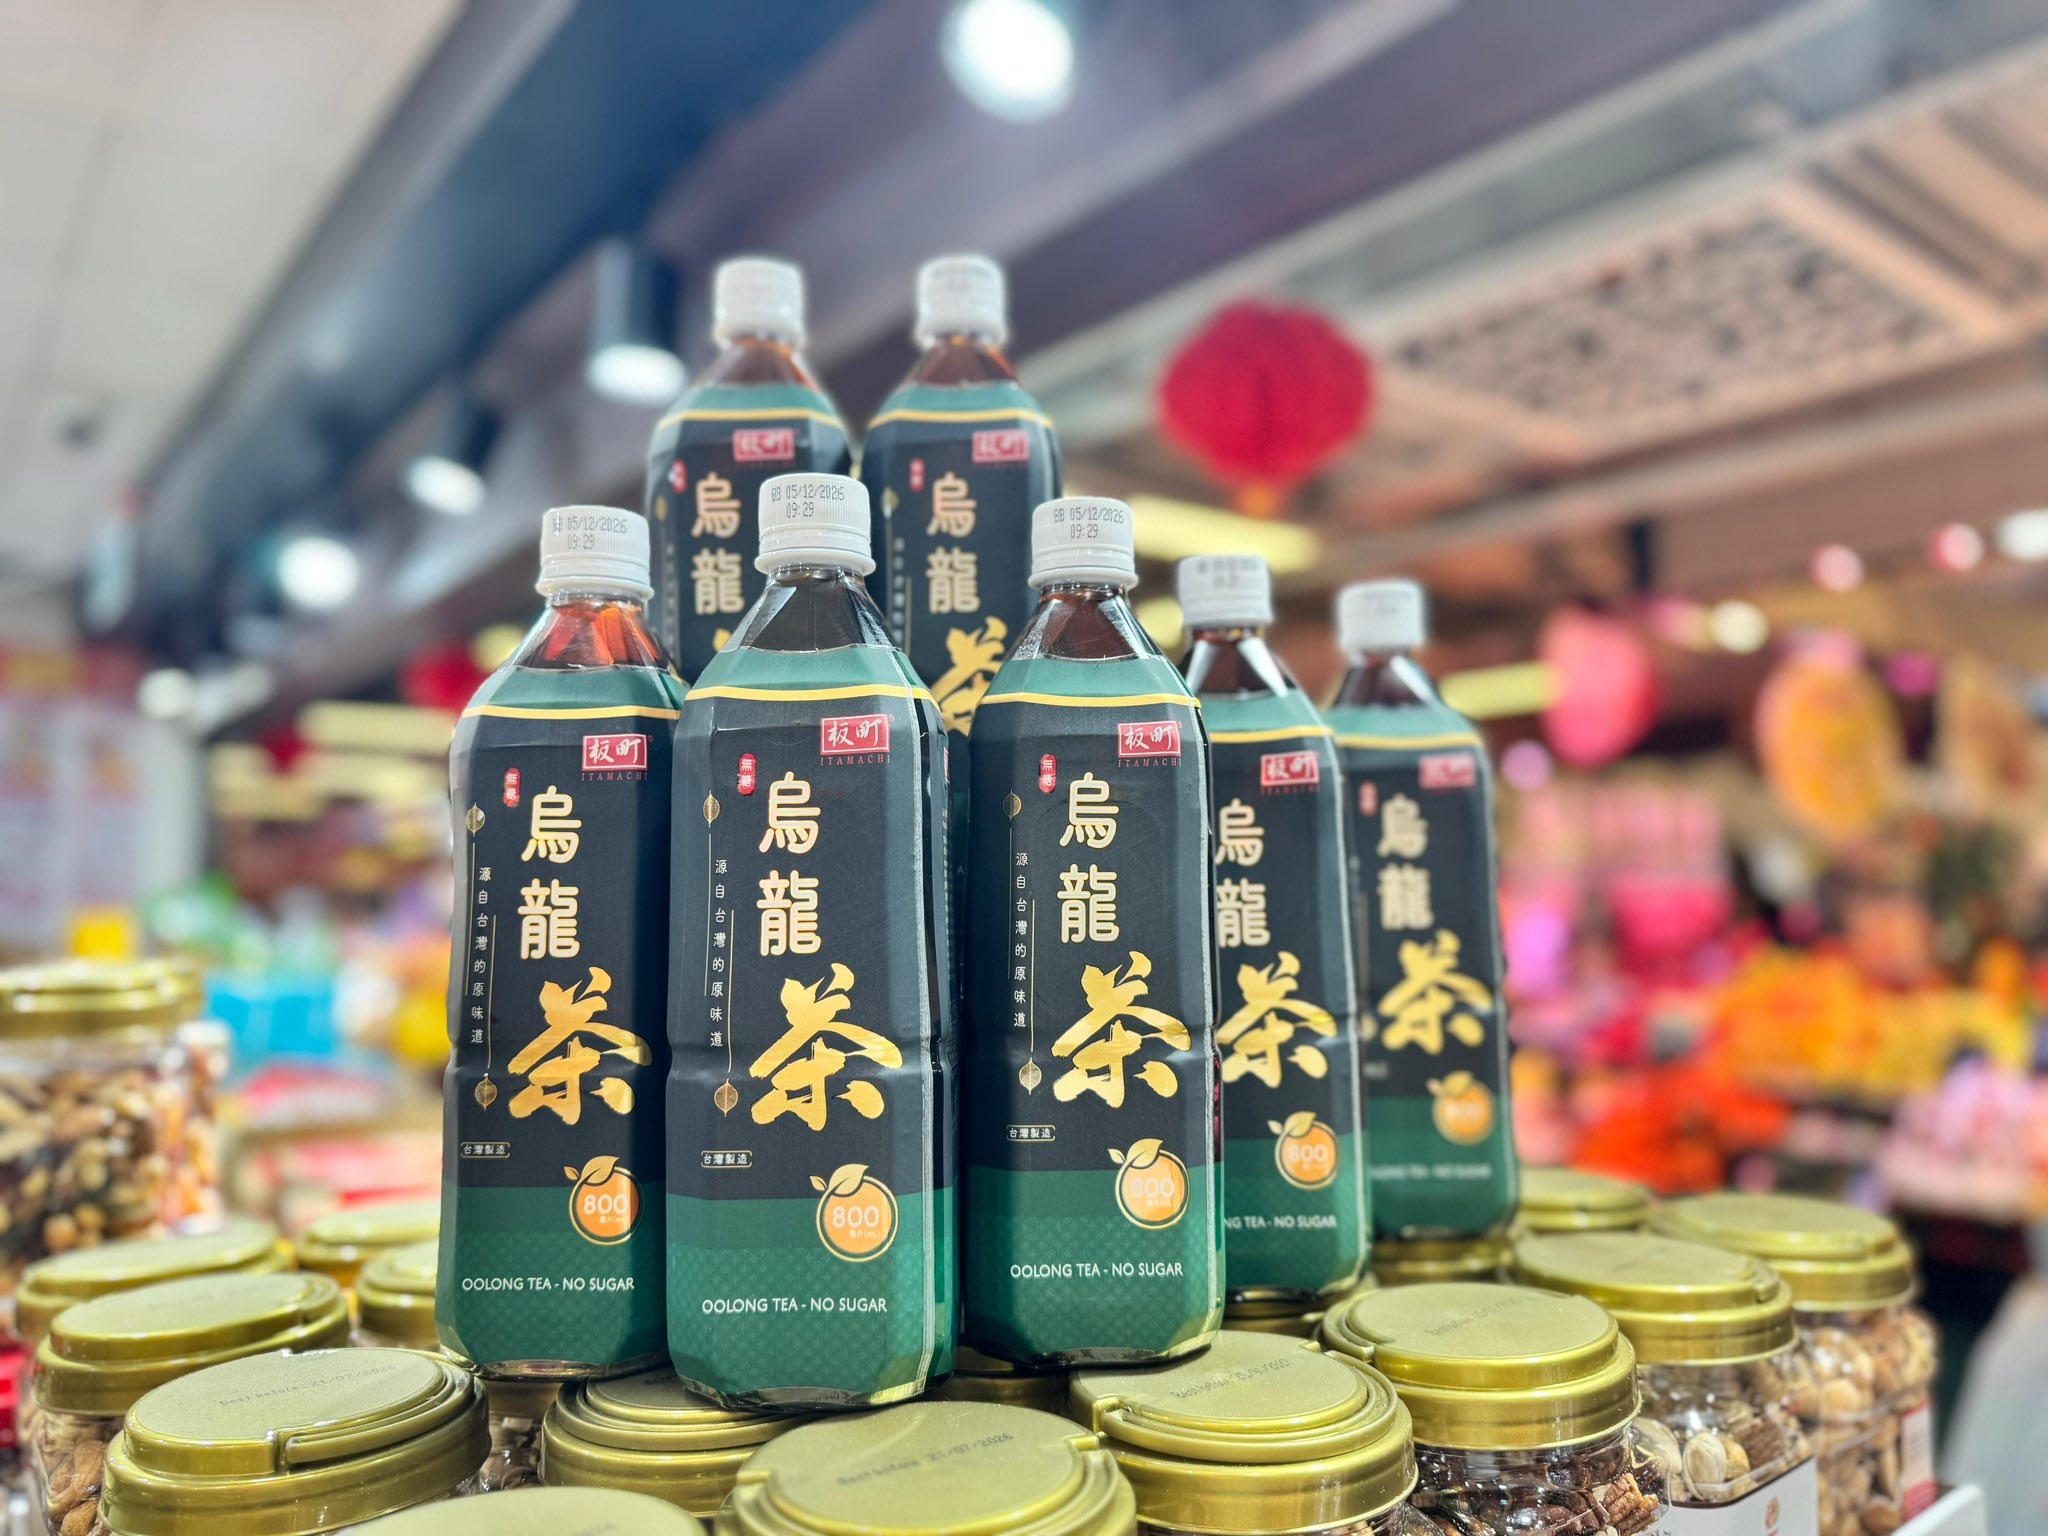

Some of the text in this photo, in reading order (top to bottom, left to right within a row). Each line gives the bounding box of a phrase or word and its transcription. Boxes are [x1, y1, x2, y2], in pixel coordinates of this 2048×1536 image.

[786, 484, 845, 501] 05/12/2026
[786, 502, 814, 518] 09:29
[1070, 506, 1124, 524] 05/12/2026
[567, 515, 628, 534] 05/12/2026
[1070, 524, 1099, 539] 09:29
[827, 719, 883, 747] 板町
[1125, 726, 1173, 751] 板町
[588, 738, 642, 764] 板町
[820, 754, 890, 766] ITAMACHI
[1118, 757, 1182, 768] ITAMACHI
[581, 771, 649, 781] ITAMACHI
[1013, 852, 1029, 1028] 源自台灣的原味道
[1051, 771, 1191, 1109] 烏龍茶
[471, 866, 492, 1044] 源自台灣的原味道
[507, 785, 653, 1125] 烏龍茶
[709, 859, 728, 1047] 源自台灣的原味道
[749, 771, 903, 1131] 烏龍茶
[1131, 1176, 1175, 1200] 800
[583, 1193, 630, 1215] 800
[833, 1205, 880, 1229] 800
[1243, 1216, 1266, 1229] TEA
[1273, 1215, 1296, 1228] NO
[1297, 1215, 1338, 1228] SUGAR
[1010, 1263, 1072, 1278] OOLONG
[1075, 1262, 1101, 1277] TEA
[1112, 1262, 1135, 1277] NO
[1138, 1262, 1184, 1277] SUGAR
[461, 1277, 524, 1291] OOLONG
[527, 1277, 552, 1291] TEA
[562, 1277, 586, 1291] NO
[589, 1276, 635, 1291] SUGAR
[702, 1297, 768, 1314] OOLONG
[772, 1297, 799, 1312] TEA
[810, 1297, 835, 1312] NO
[839, 1297, 888, 1313] SUGAR
